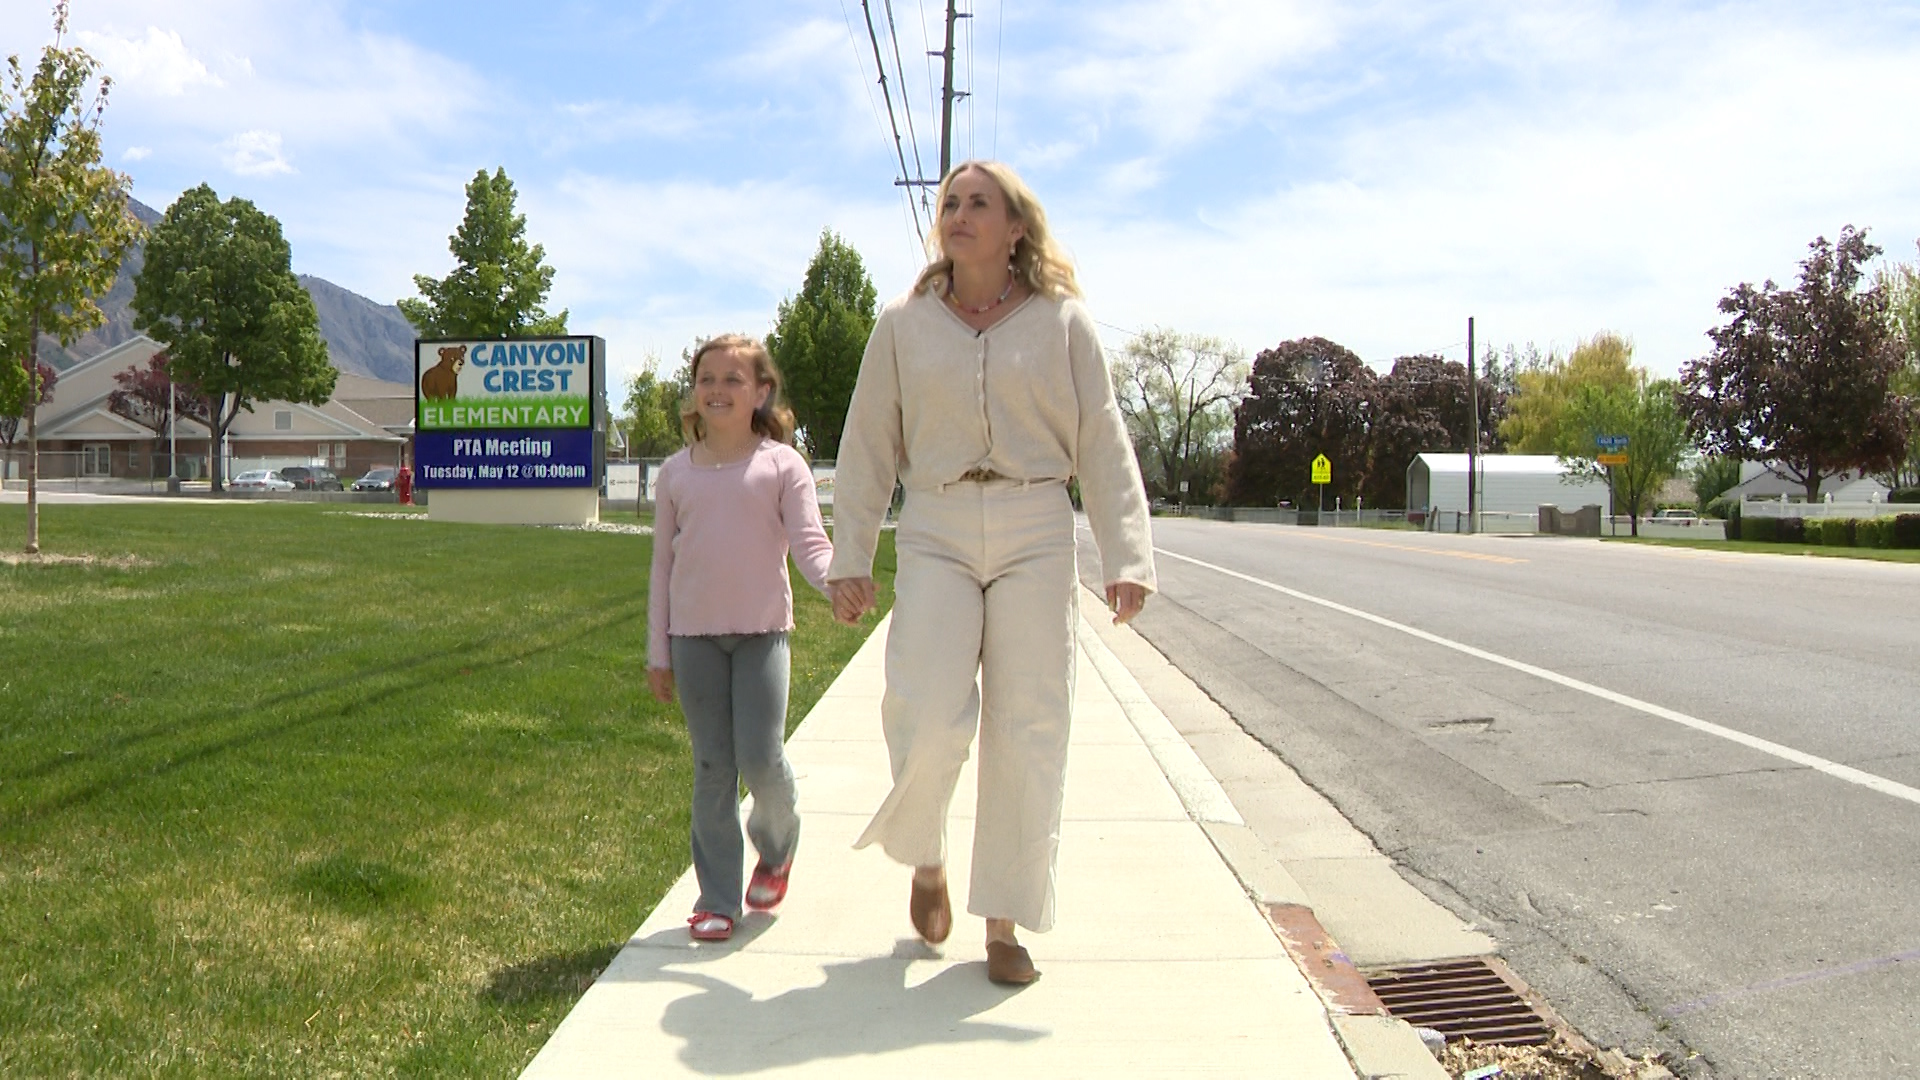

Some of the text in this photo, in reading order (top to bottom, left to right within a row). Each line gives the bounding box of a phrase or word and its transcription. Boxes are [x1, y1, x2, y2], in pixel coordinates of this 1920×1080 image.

[471, 343, 585, 367] CANYON
[483, 369, 573, 393] CREST
[423, 405, 584, 426] ELEMENTARY
[453, 437, 552, 458] PTA Meeting
[478, 464, 503, 480] May
[505, 464, 519, 478] 12
